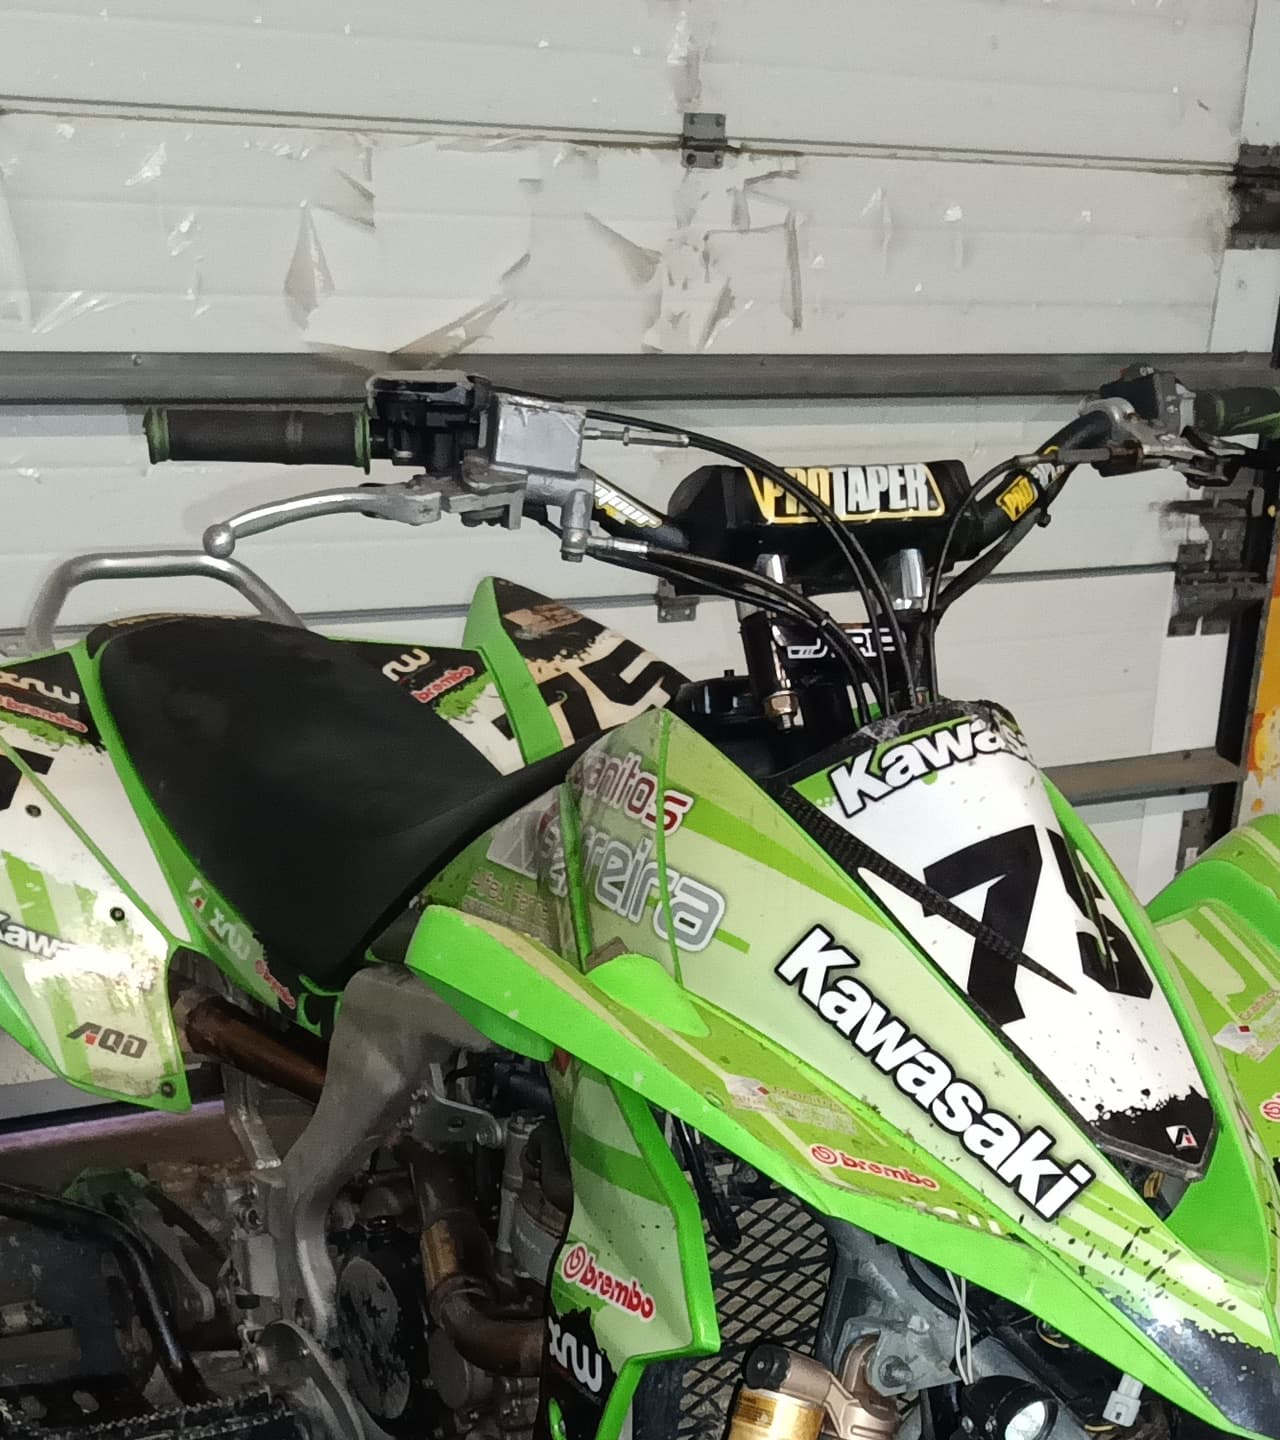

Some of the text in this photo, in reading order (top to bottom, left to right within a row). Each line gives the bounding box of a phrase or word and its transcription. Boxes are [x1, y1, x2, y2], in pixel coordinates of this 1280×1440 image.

[410, 665, 476, 704] brembo
[1, 694, 89, 734] brembo
[774, 923, 1098, 1221] Kawasaki
[838, 1150, 940, 1192] brembo
[579, 1253, 657, 1323] brembo
